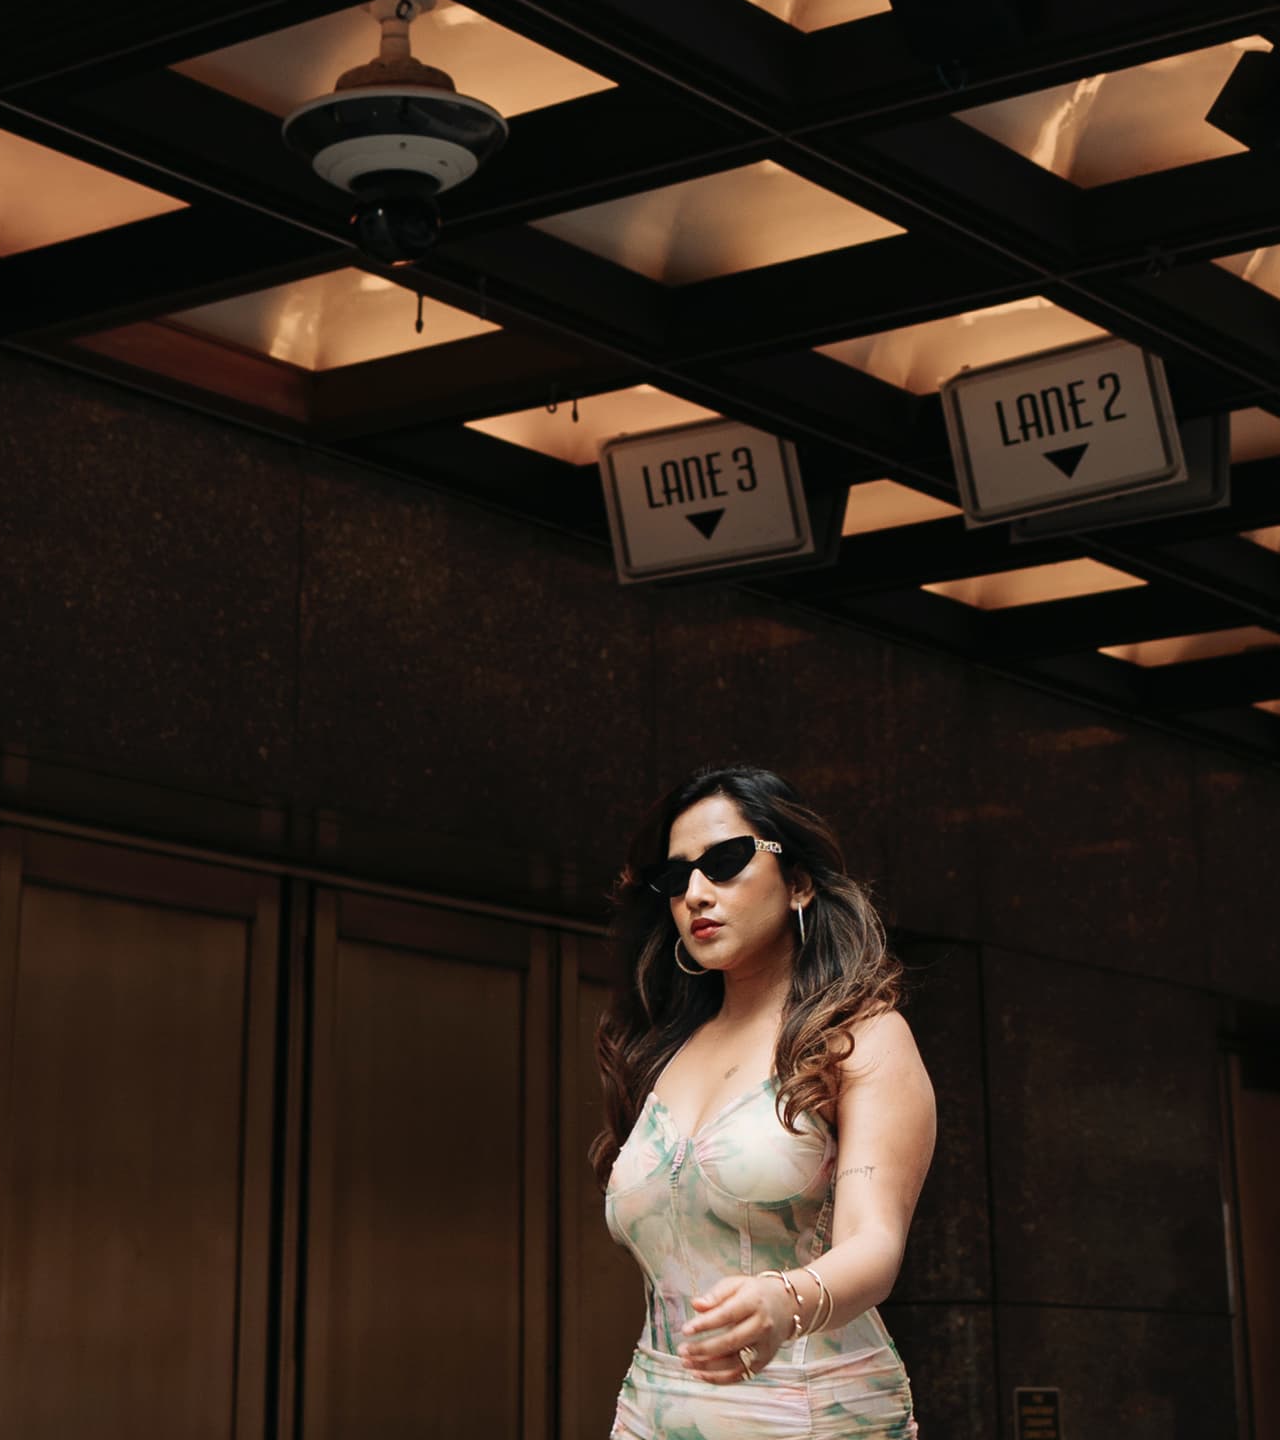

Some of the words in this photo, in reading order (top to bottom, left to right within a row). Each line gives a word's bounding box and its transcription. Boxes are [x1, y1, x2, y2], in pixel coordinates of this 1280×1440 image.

[995, 380, 1093, 446] LANE
[1098, 372, 1127, 422] 2
[642, 452, 728, 509] LANE
[732, 447, 757, 492] 3
